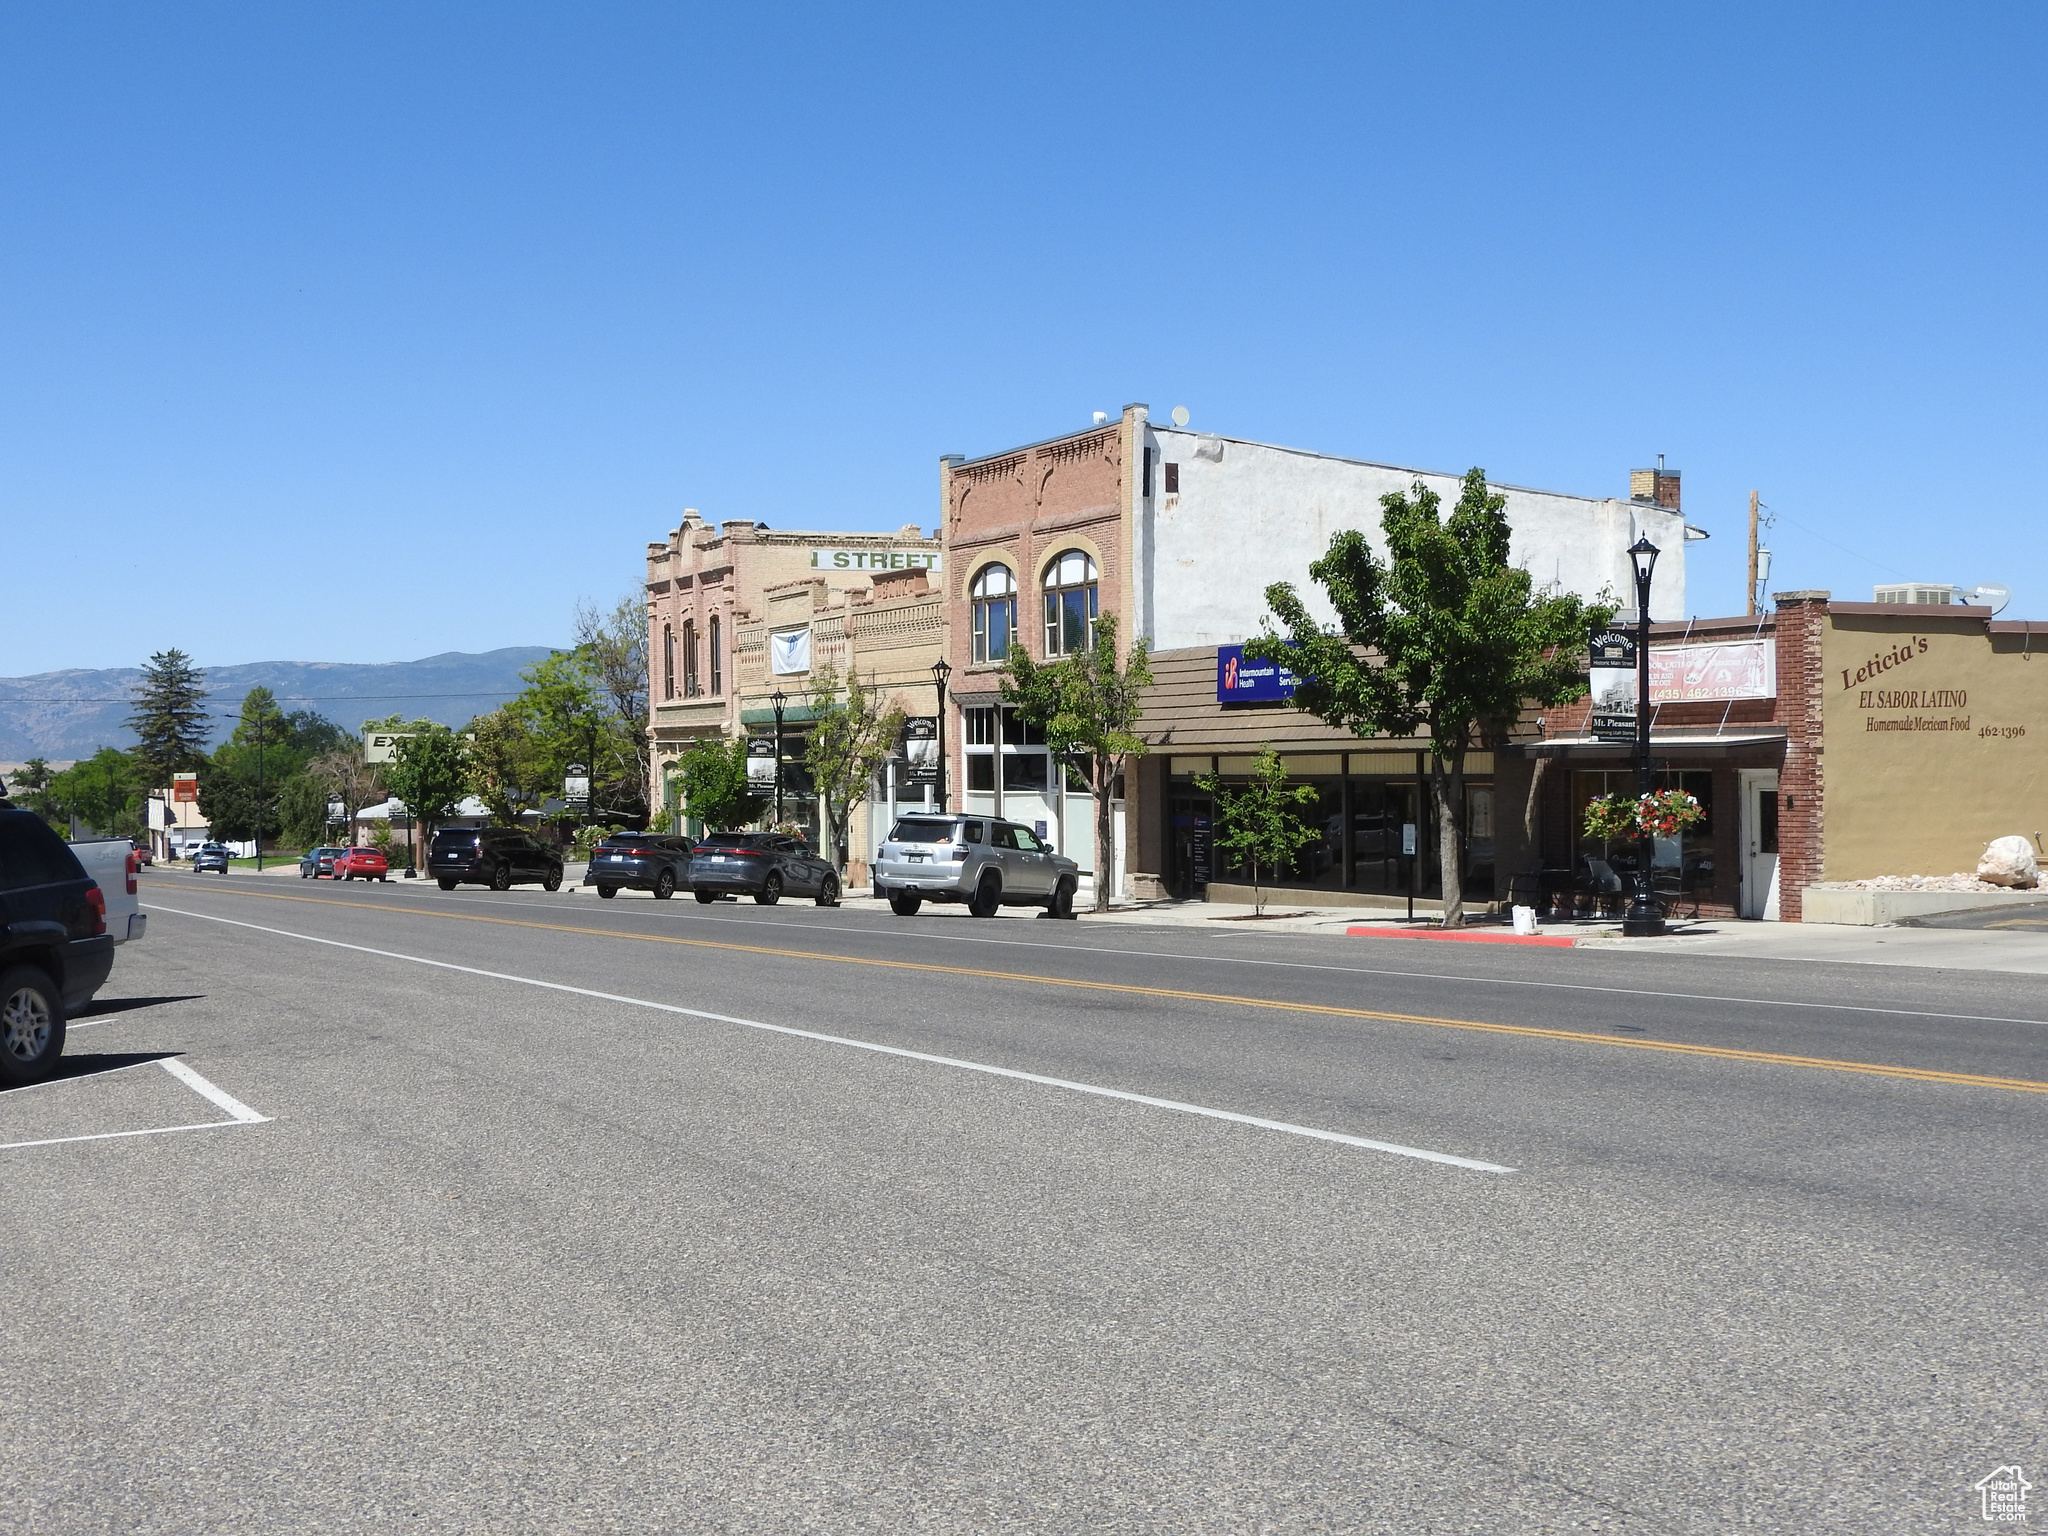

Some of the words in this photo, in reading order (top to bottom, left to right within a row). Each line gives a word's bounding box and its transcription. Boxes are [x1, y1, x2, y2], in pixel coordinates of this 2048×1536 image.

[833, 552, 938, 569] STREET
[1591, 630, 1634, 651] Welcome
[1841, 636, 1928, 690] Leticia's
[1239, 667, 1274, 678] Intermountain
[1239, 679, 1254, 688] Health
[1654, 689, 1683, 699] (435)
[1687, 686, 1742, 698] 462-1396
[1859, 691, 1875, 708] EL
[1877, 690, 1918, 708] SABOR
[1921, 690, 1967, 708] LATINO
[907, 718, 935, 729] Welcome
[1593, 719, 1606, 727] Mt.
[1607, 718, 1636, 727] Pleasant
[1866, 715, 1913, 731] Homemade
[1914, 716, 1948, 731] Mexican
[1950, 715, 1970, 731] Food
[749, 739, 774, 749] Welcome
